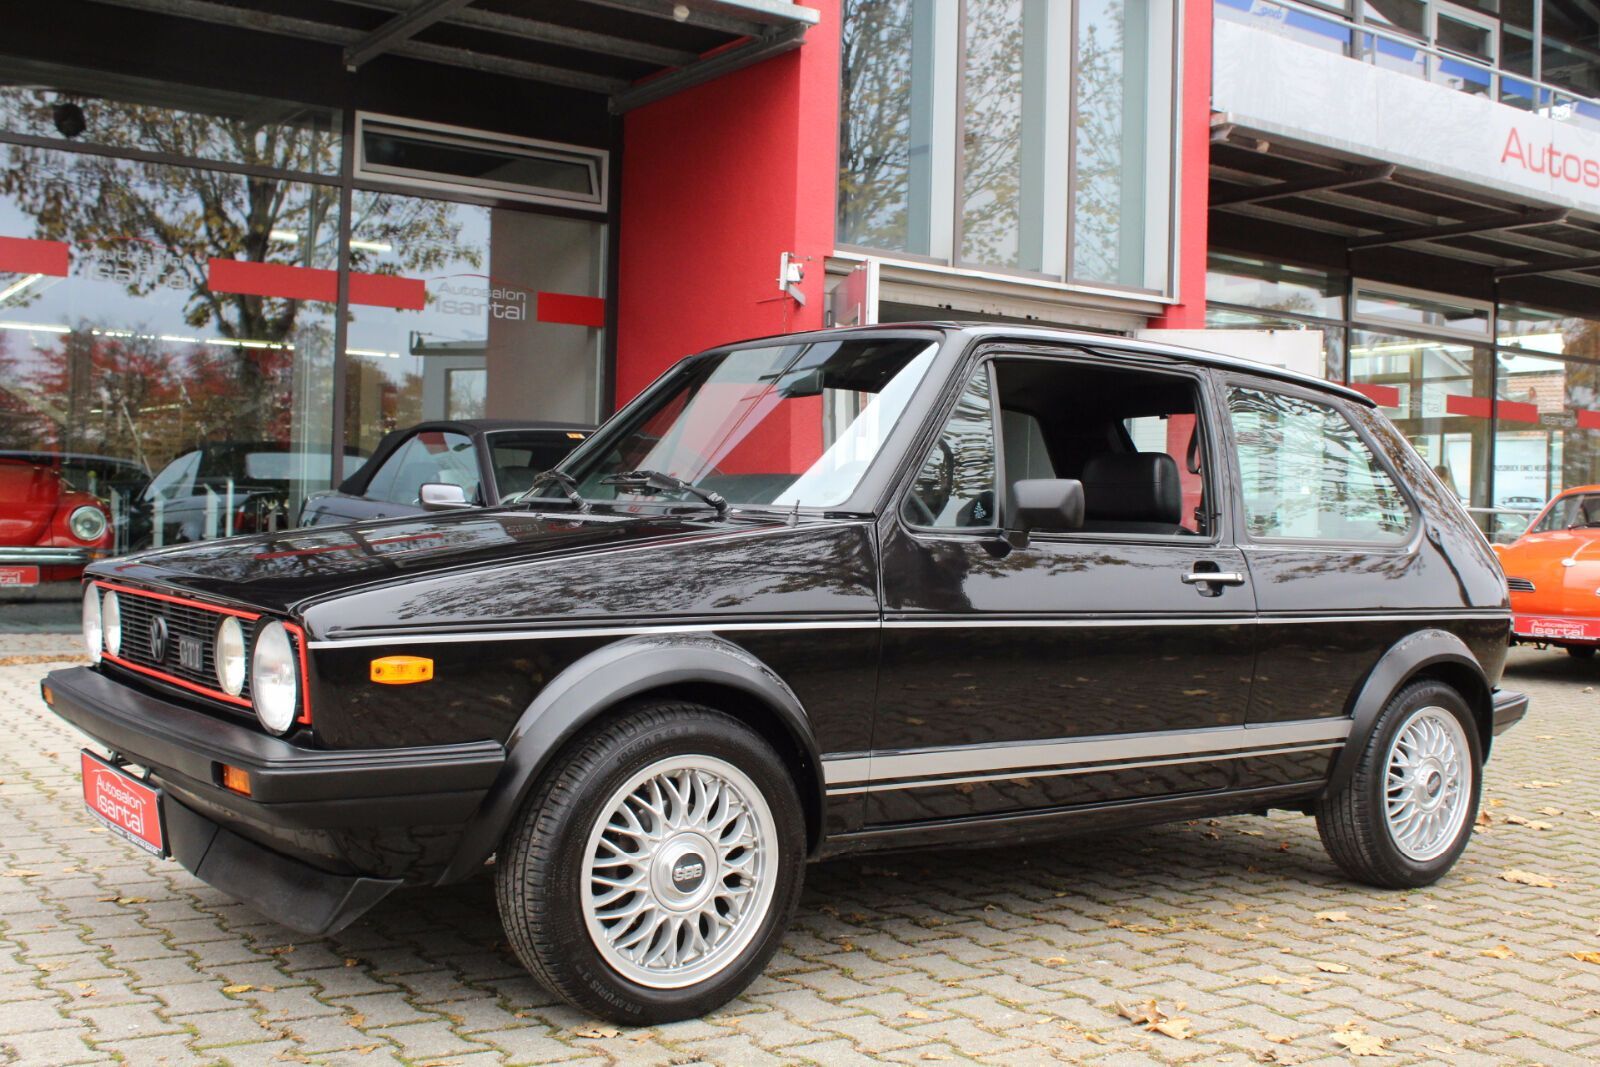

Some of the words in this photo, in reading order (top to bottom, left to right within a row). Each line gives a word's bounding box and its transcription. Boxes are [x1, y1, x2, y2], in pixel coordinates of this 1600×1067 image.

[437, 281, 526, 301] Autosalon
[1531, 624, 1585, 637] Isartal
[179, 639, 200, 668] GTI
[96, 773, 141, 809] Autosalon
[96, 784, 145, 836] Isartal
